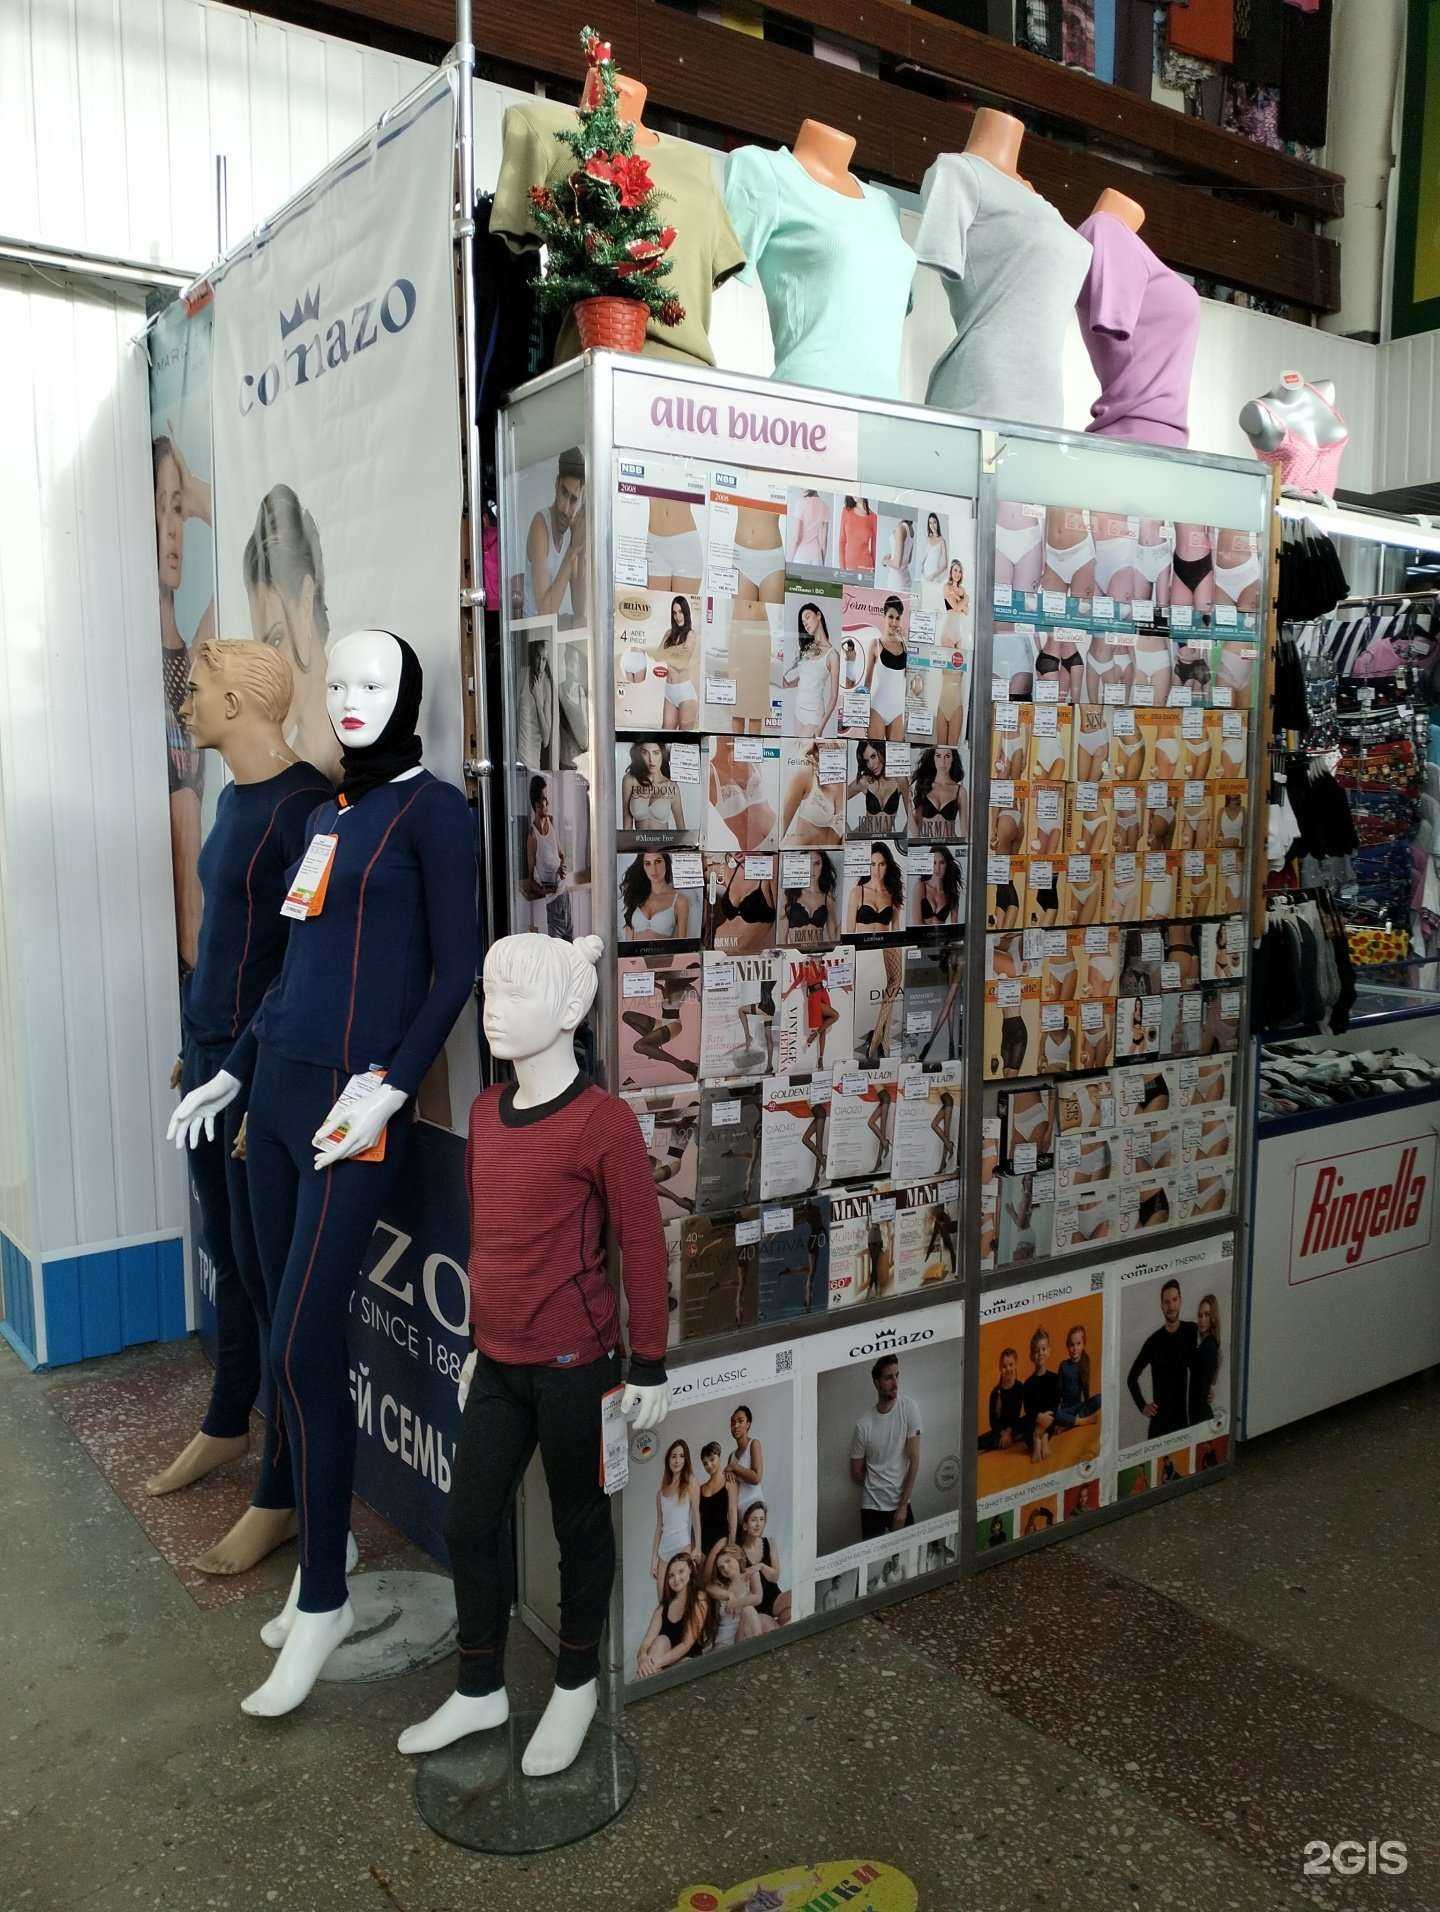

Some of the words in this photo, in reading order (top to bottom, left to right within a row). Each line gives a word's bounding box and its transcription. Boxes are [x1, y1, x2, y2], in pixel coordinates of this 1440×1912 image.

[239, 279, 417, 417] comazo
[650, 394, 718, 436] alla
[728, 405, 828, 453] buone
[621, 463, 644, 475] NBB
[716, 474, 736, 485] NBB
[842, 592, 867, 614] Form
[868, 604, 885, 614] time
[620, 630, 628, 643] 4
[630, 630, 646, 638] ADET
[631, 785, 677, 797] FREEDOM
[870, 988, 905, 1001] DIVA
[788, 1006, 801, 1065] VINTAGE
[770, 1087, 806, 1100] GOLDEN
[906, 1185, 938, 1208] MiNi
[1300, 1146, 1427, 1265] Ringella
[1120, 1262, 1169, 1280] comazo
[1175, 1252, 1207, 1267] THERMO
[1037, 1286, 1073, 1302] THERMO
[361, 1297, 419, 1357] SINCE
[427, 1335, 461, 1384] 188
[849, 1328, 935, 1360] comazo
[703, 1367, 748, 1388] CLASSIC
[380, 1394, 457, 1495] СЕМЬ
